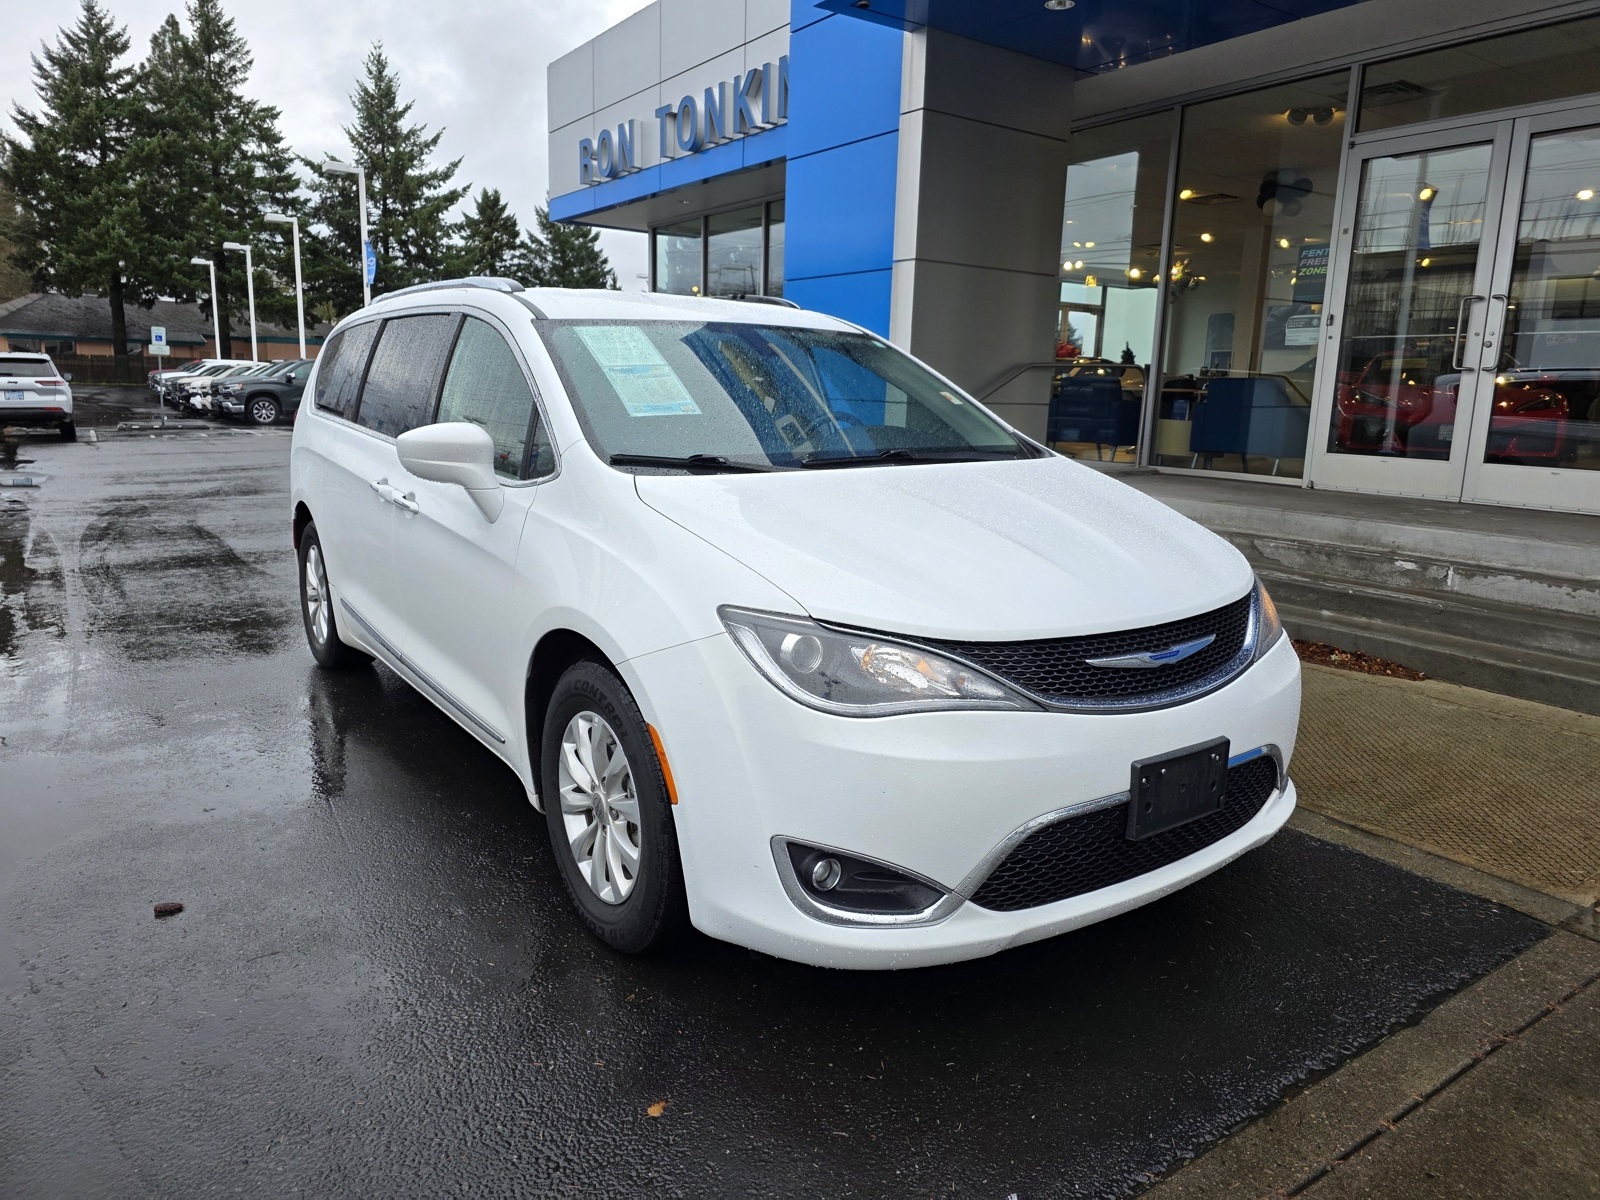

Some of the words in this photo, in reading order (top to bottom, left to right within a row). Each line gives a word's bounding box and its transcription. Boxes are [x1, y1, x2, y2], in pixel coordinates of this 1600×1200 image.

[579, 119, 638, 185] RON
[1299, 267, 1328, 276] ZONE
[1300, 257, 1329, 266] FREE
[574, 679, 629, 739] CONTROL
